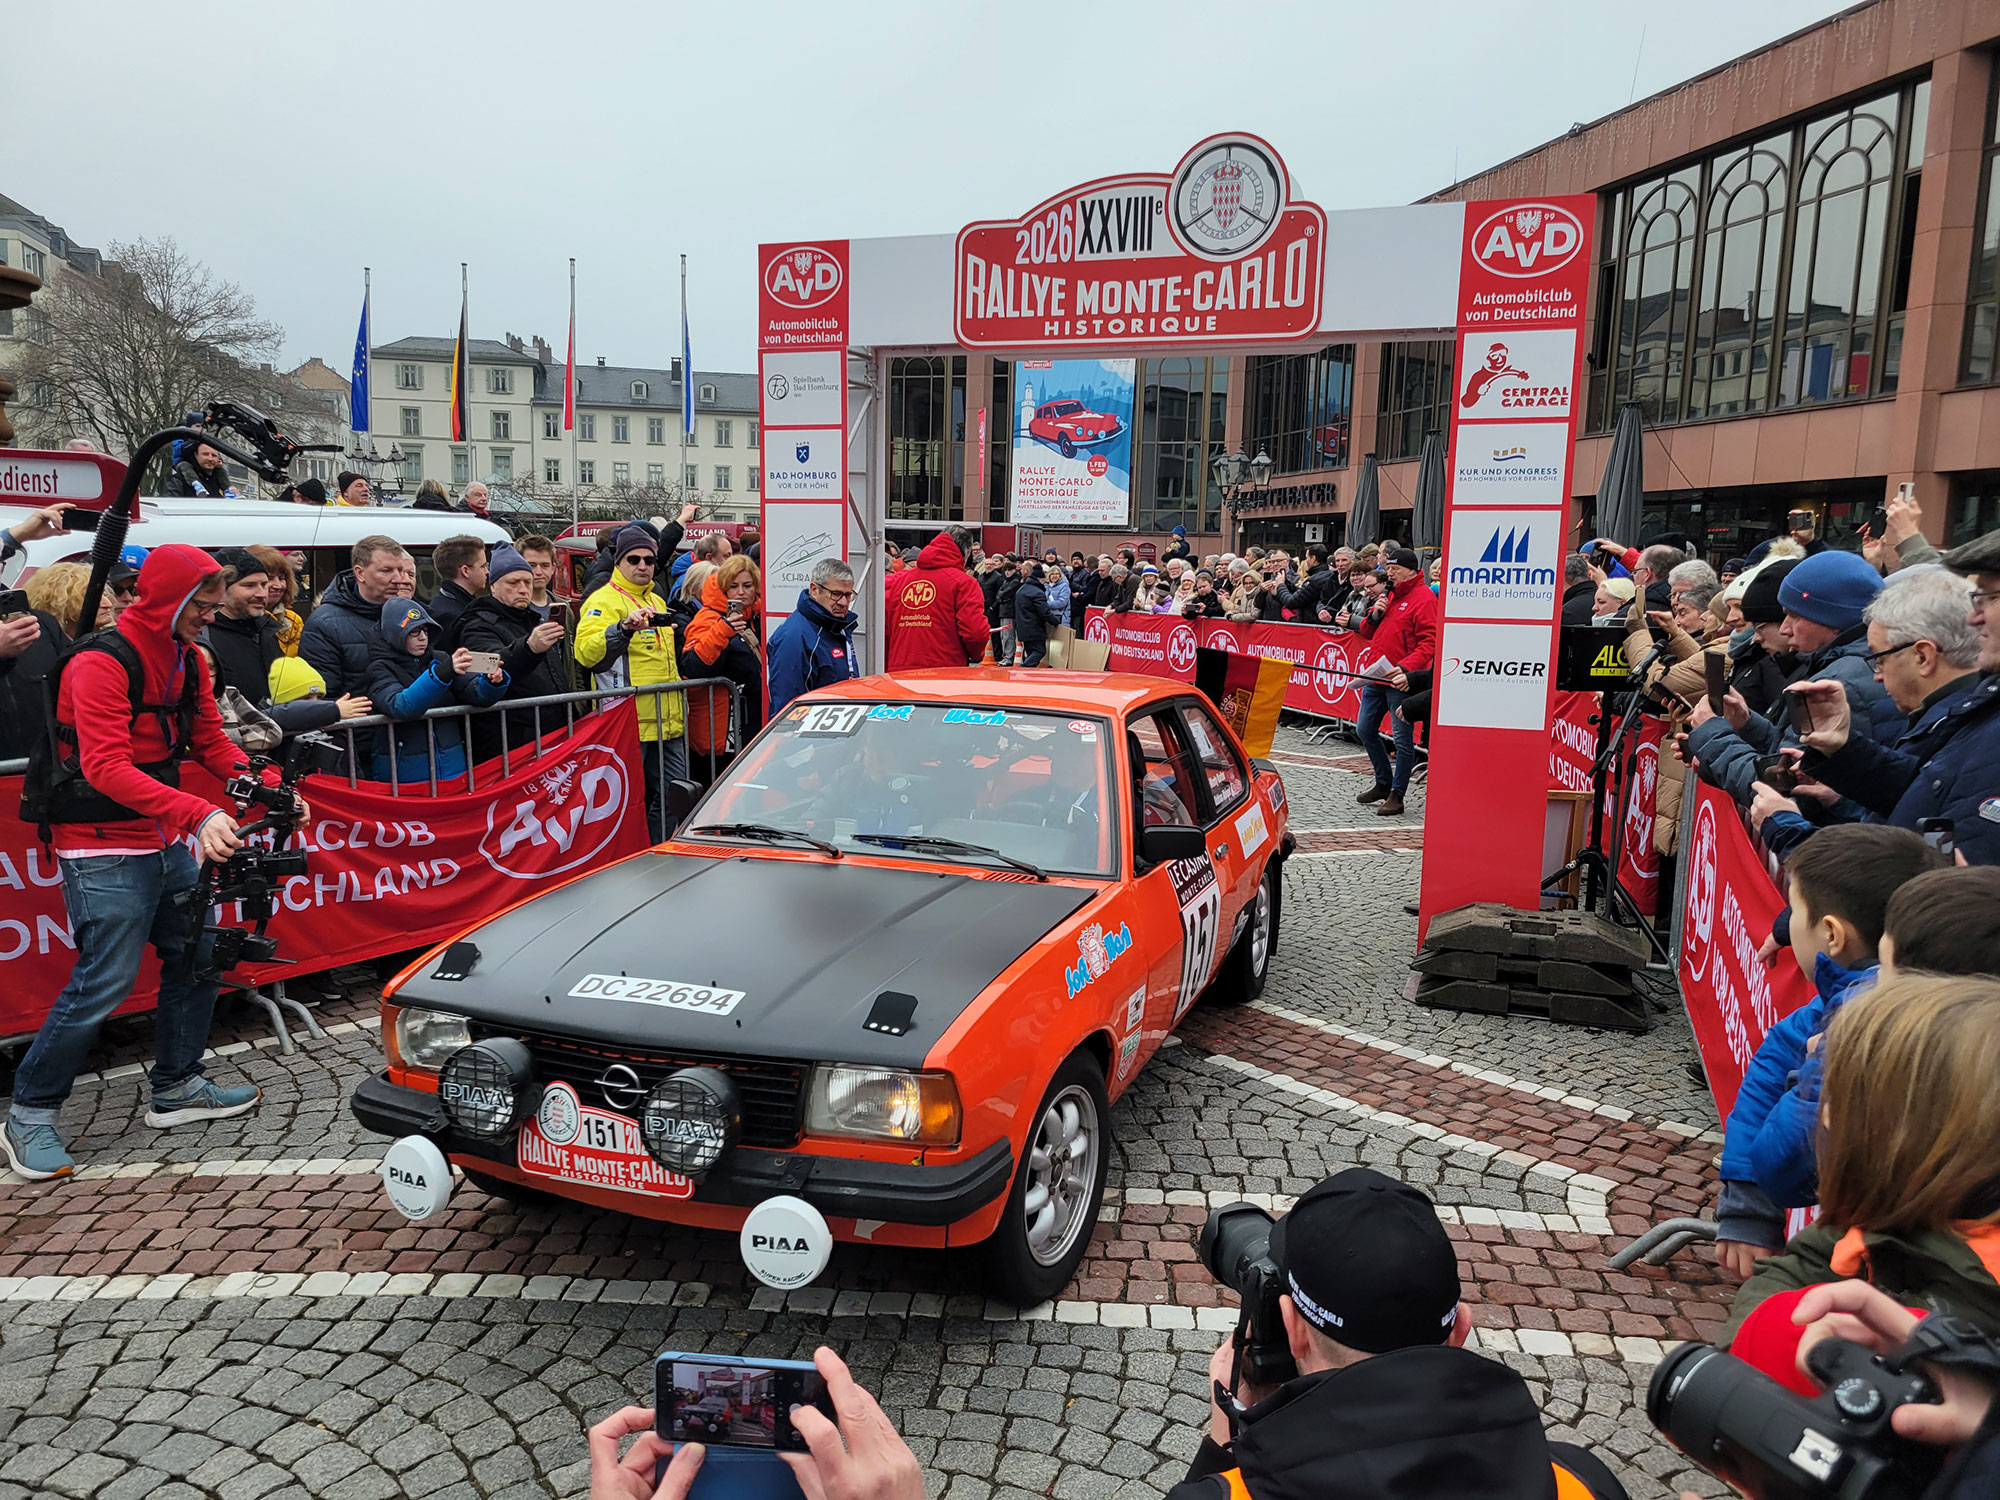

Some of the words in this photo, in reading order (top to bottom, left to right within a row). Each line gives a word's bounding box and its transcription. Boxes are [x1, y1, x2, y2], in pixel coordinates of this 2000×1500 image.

[1015, 203, 1073, 265] 2026
[966, 253, 1066, 319] RALLYE
[1076, 237, 1308, 316] MONTE-CARLO
[1473, 288, 1572, 305] Automobilclub
[1465, 311, 1489, 321] von
[1494, 304, 1577, 320] Deutschland
[769, 317, 839, 330] Automobilclub
[1044, 316, 1217, 336] HISTORIQUE
[764, 335, 781, 344] von
[784, 331, 843, 344] Deutschland
[792, 375, 826, 384] Spielbank
[793, 383, 806, 391] Bad
[808, 384, 839, 392] Homburg
[1502, 387, 1569, 397] CENTRAL
[1501, 397, 1569, 408] GARAGE
[770, 471, 788, 480] BAD
[790, 471, 837, 480] HOMBURG
[1019, 466, 1056, 475] RALLYE
[1459, 468, 1479, 476] KUR
[1481, 468, 1503, 476] UND
[1505, 467, 1558, 476] KONGRESS
[1019, 477, 1094, 486] MONTE-CARLO
[1018, 488, 1079, 497] HISTORIQUE
[782, 572, 810, 582] SCHRA
[1451, 567, 1554, 585] MARITIM
[1451, 587, 1478, 598] Hotel
[1481, 588, 1501, 598] Bad
[1505, 588, 1553, 601] Homburg
[1115, 627, 1161, 643] AUTOMOBILCLUB
[1112, 643, 1122, 654] VON
[1124, 645, 1164, 661] DEUTSCHLAND
[1462, 660, 1546, 677] SENGER
[811, 707, 857, 731] 151
[944, 710, 1008, 725] Wash
[1169, 862, 1183, 889] LE
[1180, 870, 1213, 903] MONTE-CARLO
[577, 977, 626, 996] DC
[625, 981, 734, 1011] 22694
[443, 1082, 508, 1109] PIAA
[583, 1116, 617, 1149] 151
[645, 1116, 720, 1141] PIAA
[522, 1127, 571, 1169] RALLYE
[389, 1166, 427, 1188] PIAA
[560, 1168, 645, 1190] HISTORIQUE
[752, 1234, 810, 1252] PIAA
